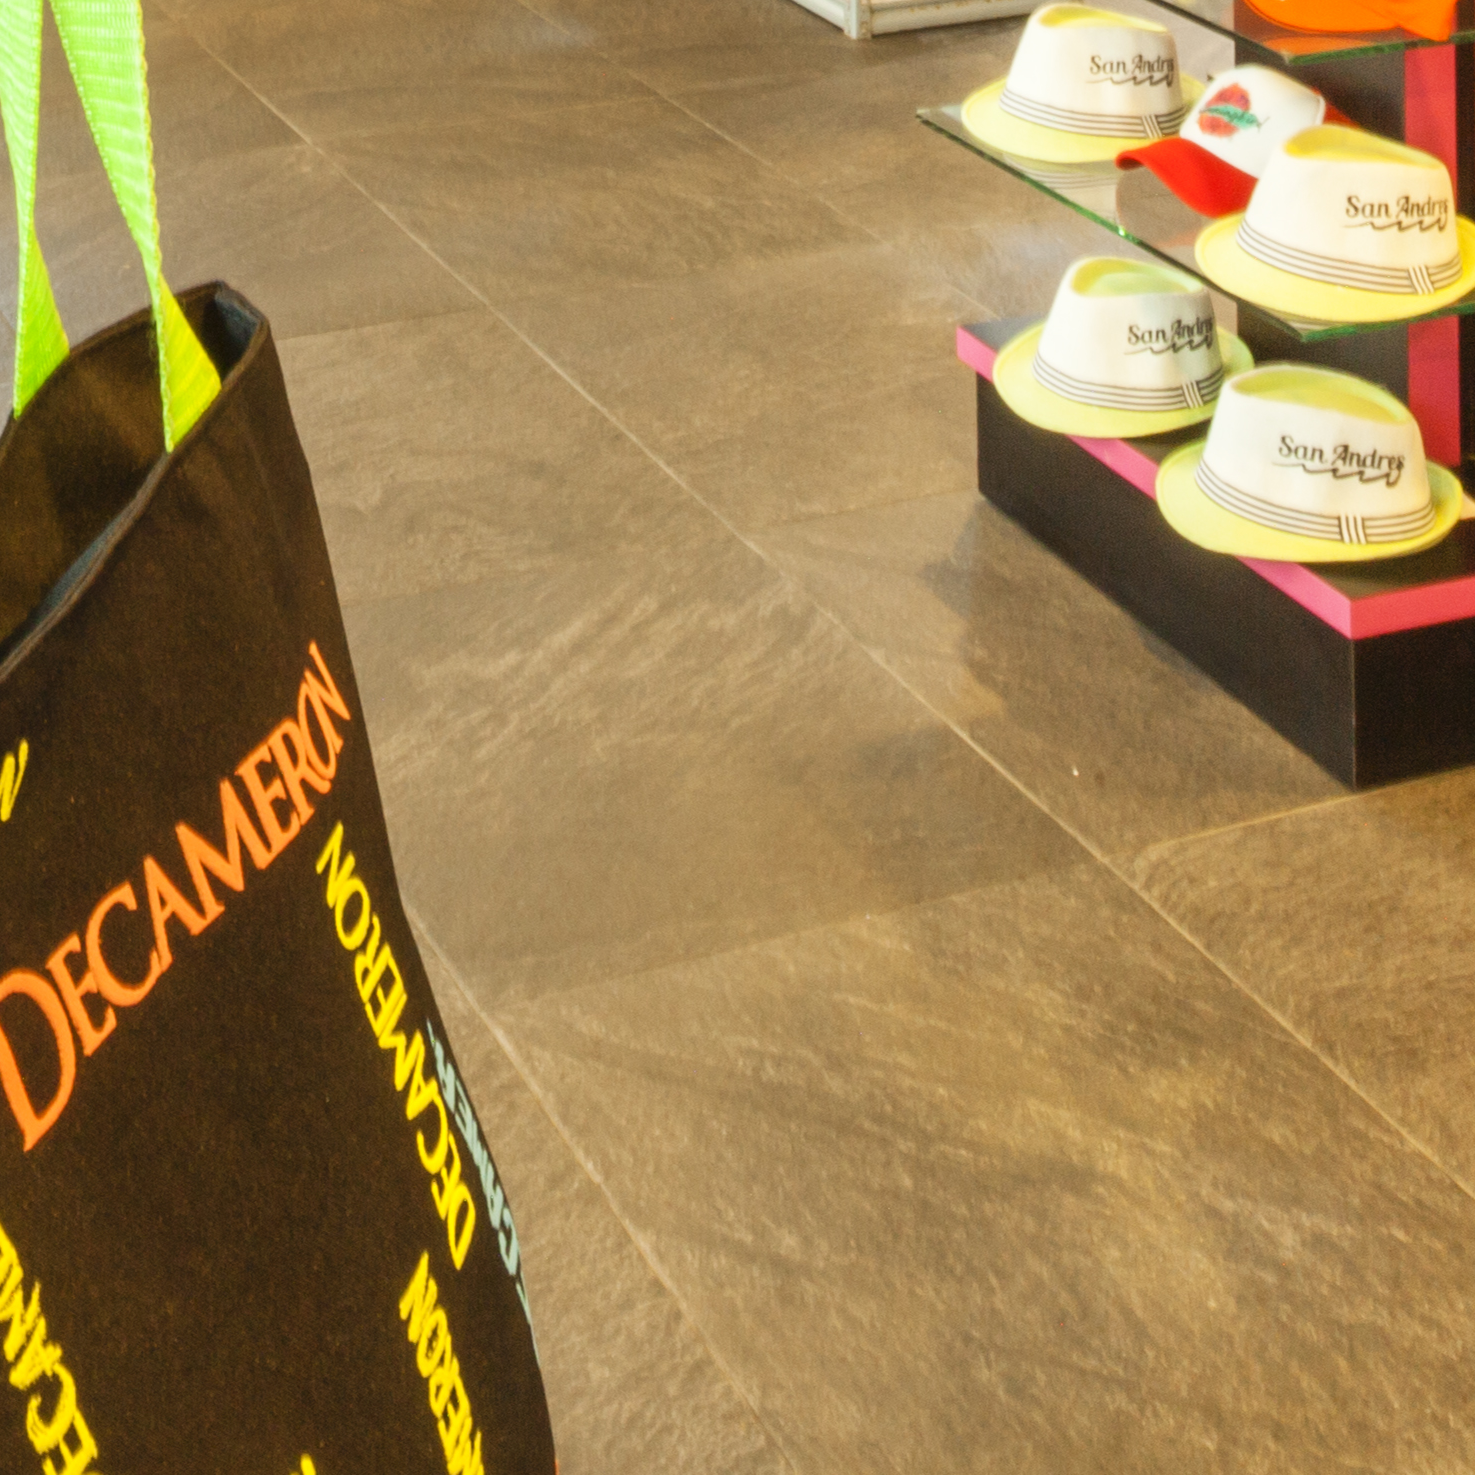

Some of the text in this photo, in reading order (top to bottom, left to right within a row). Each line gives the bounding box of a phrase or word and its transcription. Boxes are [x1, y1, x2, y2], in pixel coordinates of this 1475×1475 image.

[1090, 54, 1128, 75] San
[1346, 195, 1393, 219] San
[1128, 323, 1169, 345] San
[1278, 434, 1328, 465] San
[316, 822, 476, 1271] DECAMERON
